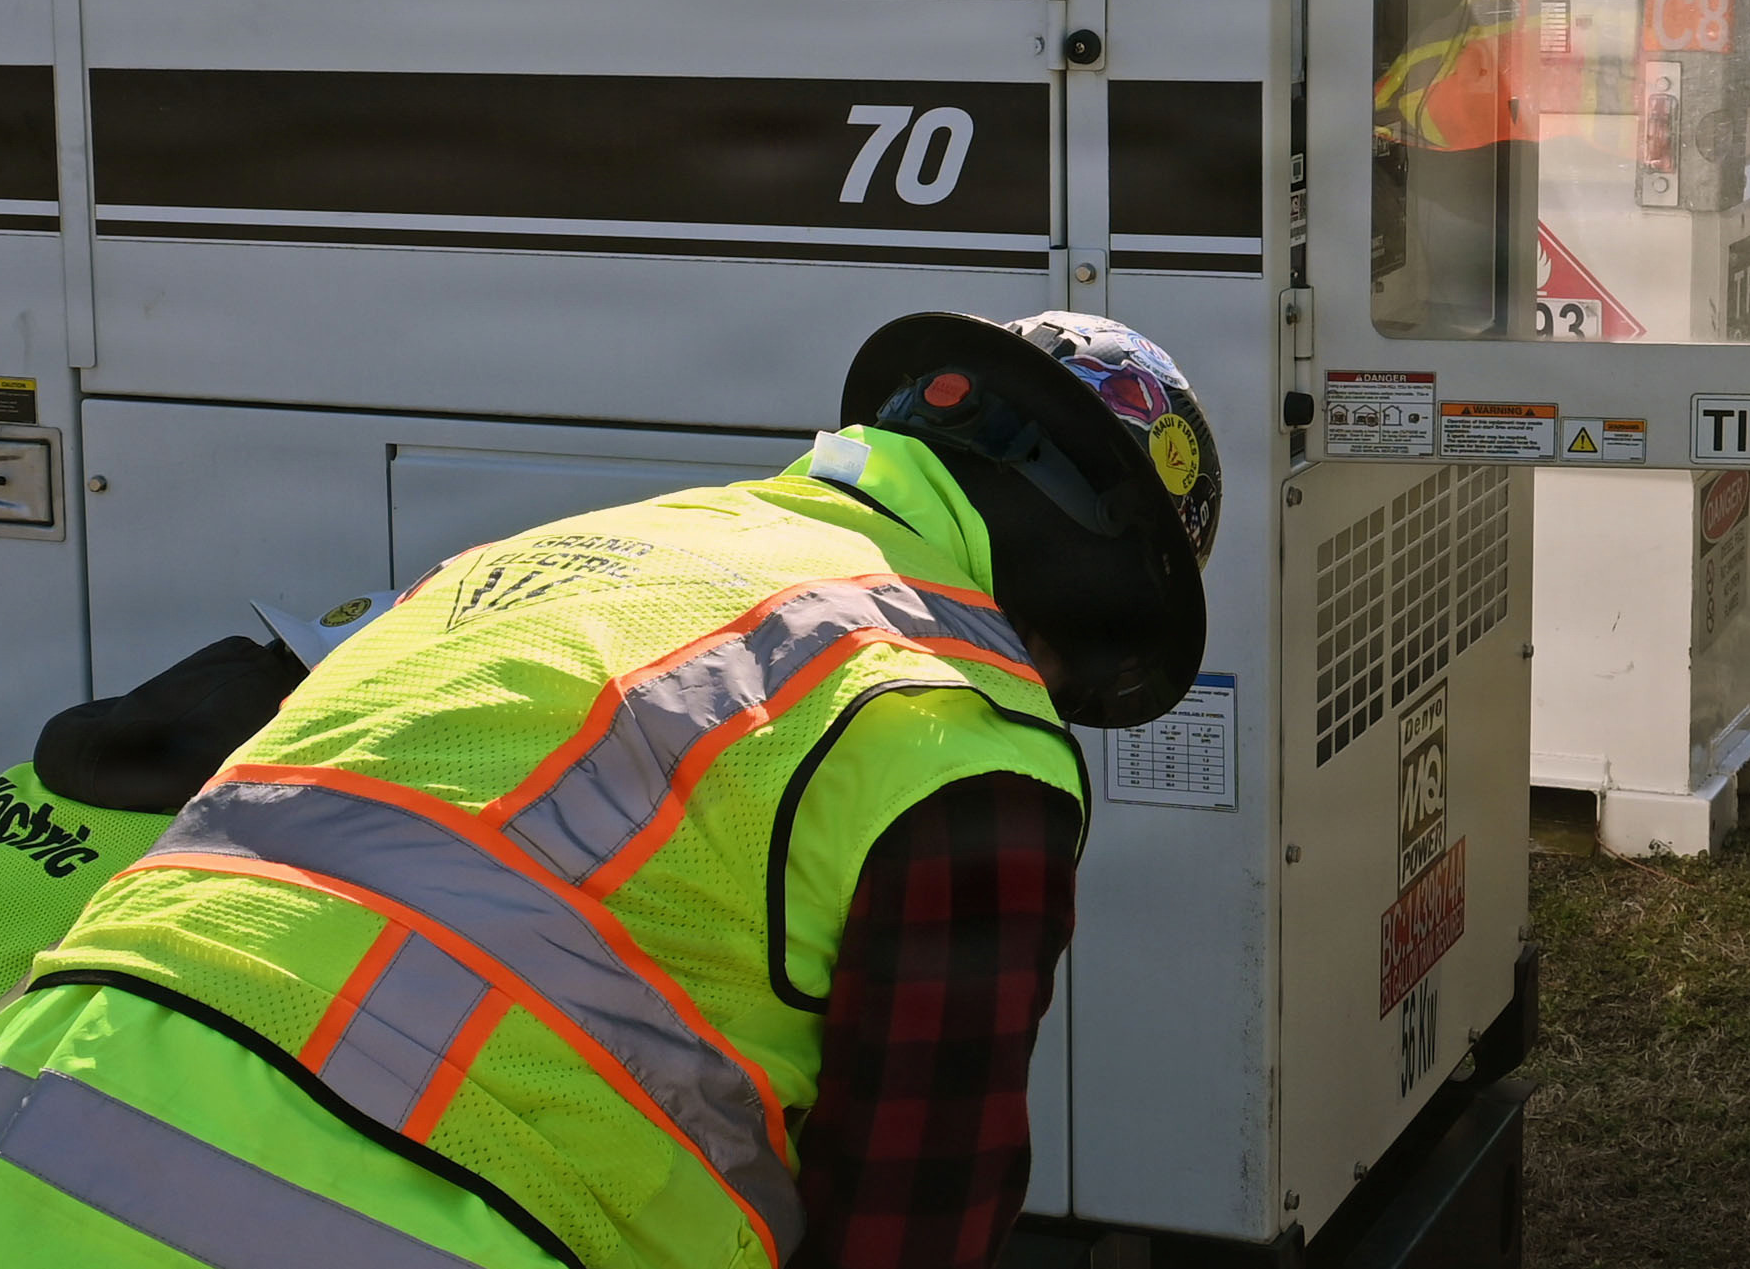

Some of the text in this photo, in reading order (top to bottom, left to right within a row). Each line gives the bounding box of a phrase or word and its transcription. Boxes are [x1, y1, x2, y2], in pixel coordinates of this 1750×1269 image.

[839, 104, 974, 206] 70
[1364, 374, 1407, 382] DANGER
[1473, 405, 1523, 415] WARNING
[1152, 417, 1197, 489] MAUI FIRES 2023
[1707, 476, 1743, 531] DANGER
[487, 552, 640, 579] ELECTRIC
[533, 535, 655, 558] GRAND
[1405, 698, 1443, 746] Denyo
[1402, 744, 1444, 833] MQ
[1402, 820, 1443, 884] POWER
[1402, 989, 1416, 1099] 56
